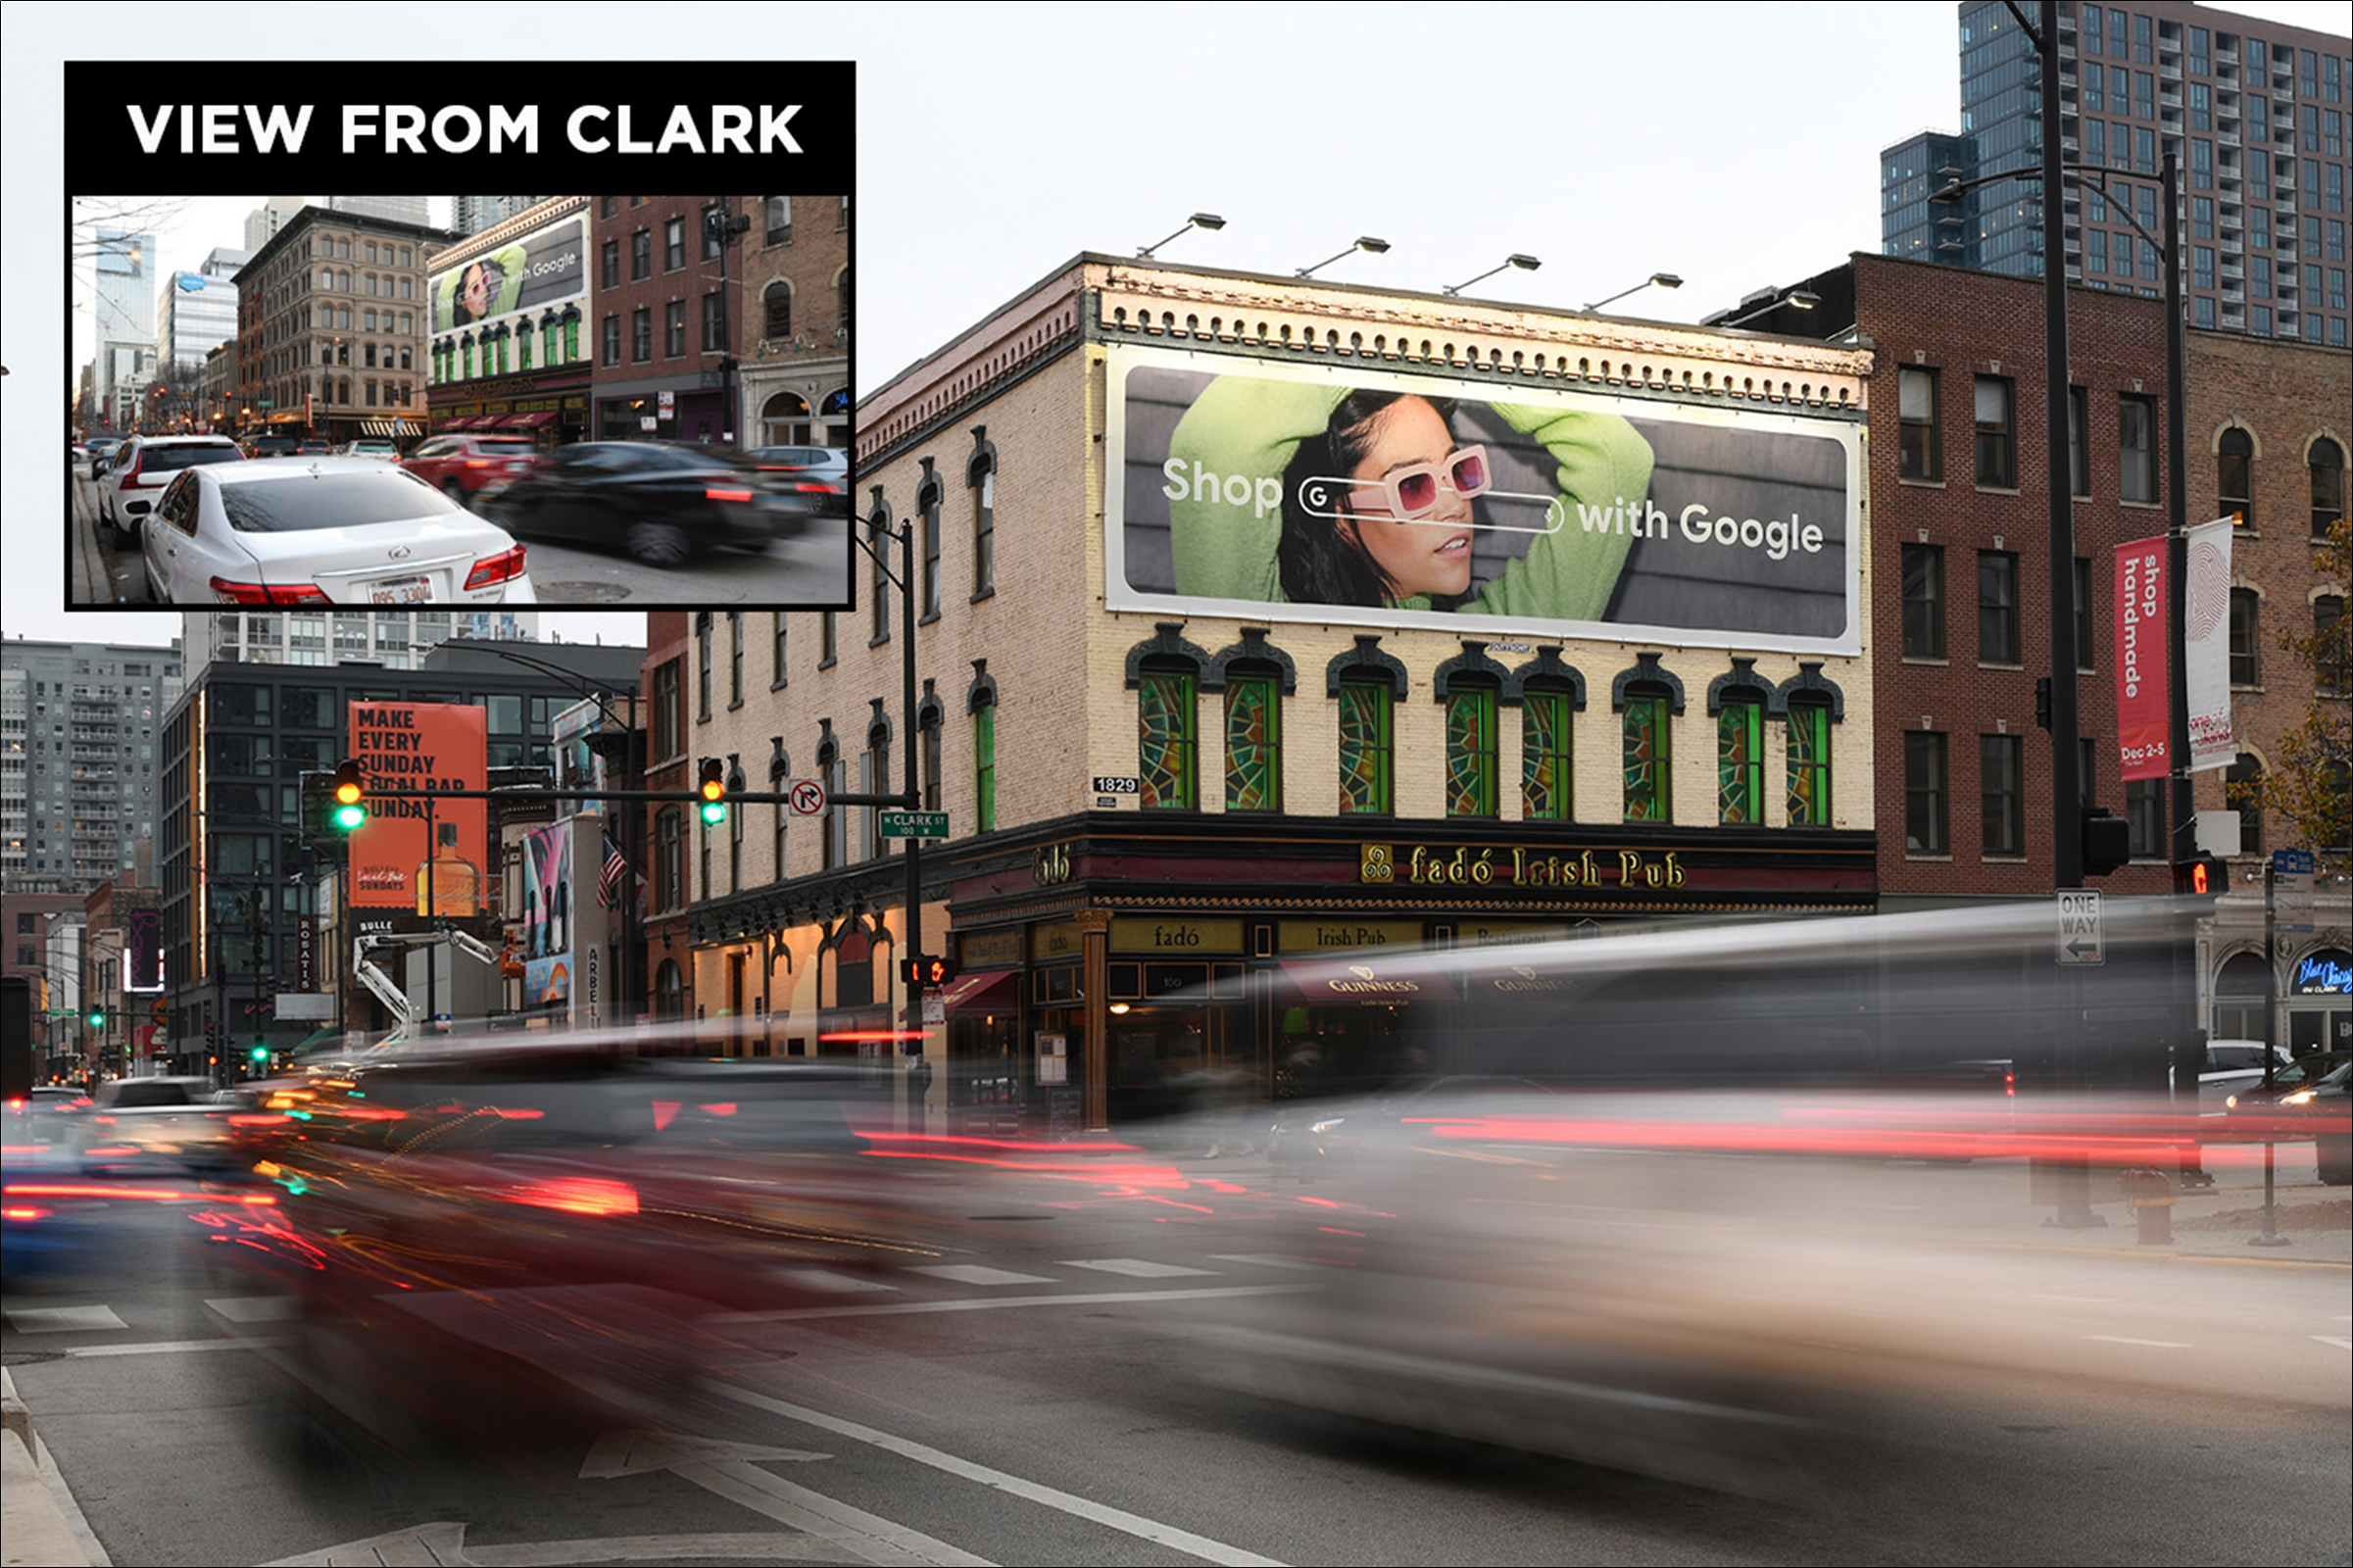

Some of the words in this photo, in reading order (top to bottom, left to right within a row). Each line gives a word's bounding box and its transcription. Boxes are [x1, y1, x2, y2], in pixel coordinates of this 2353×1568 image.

[509, 267, 531, 285] with
[532, 252, 576, 277] Google
[1162, 458, 1283, 518] Shop
[1577, 496, 1668, 539] with
[1680, 504, 1824, 561] Google
[2142, 555, 2160, 617] shop
[2125, 558, 2140, 699] handmade
[359, 709, 415, 728] MAKE
[359, 732, 422, 751] EVERY
[2122, 747, 2144, 760] Dec
[2145, 742, 2165, 757] 2-5
[359, 754, 435, 774] SUNDAY
[361, 777, 417, 792] OCAL
[1098, 777, 1136, 793] 1829
[893, 814, 932, 826] CLARK
[935, 816, 945, 825] ST
[1409, 846, 1494, 885] fadó
[1512, 848, 1602, 887] Irish
[1619, 850, 1687, 889] Pub
[2062, 896, 2096, 913] ONE
[2062, 917, 2097, 934] WAY
[1154, 925, 1200, 948] fadó
[1317, 927, 1352, 946] Irish
[1356, 927, 1386, 946] Pub
[301, 920, 310, 990] ROSATIS
[2299, 957, 2323, 985] Blue
[1328, 979, 1419, 994] GUINNESS
